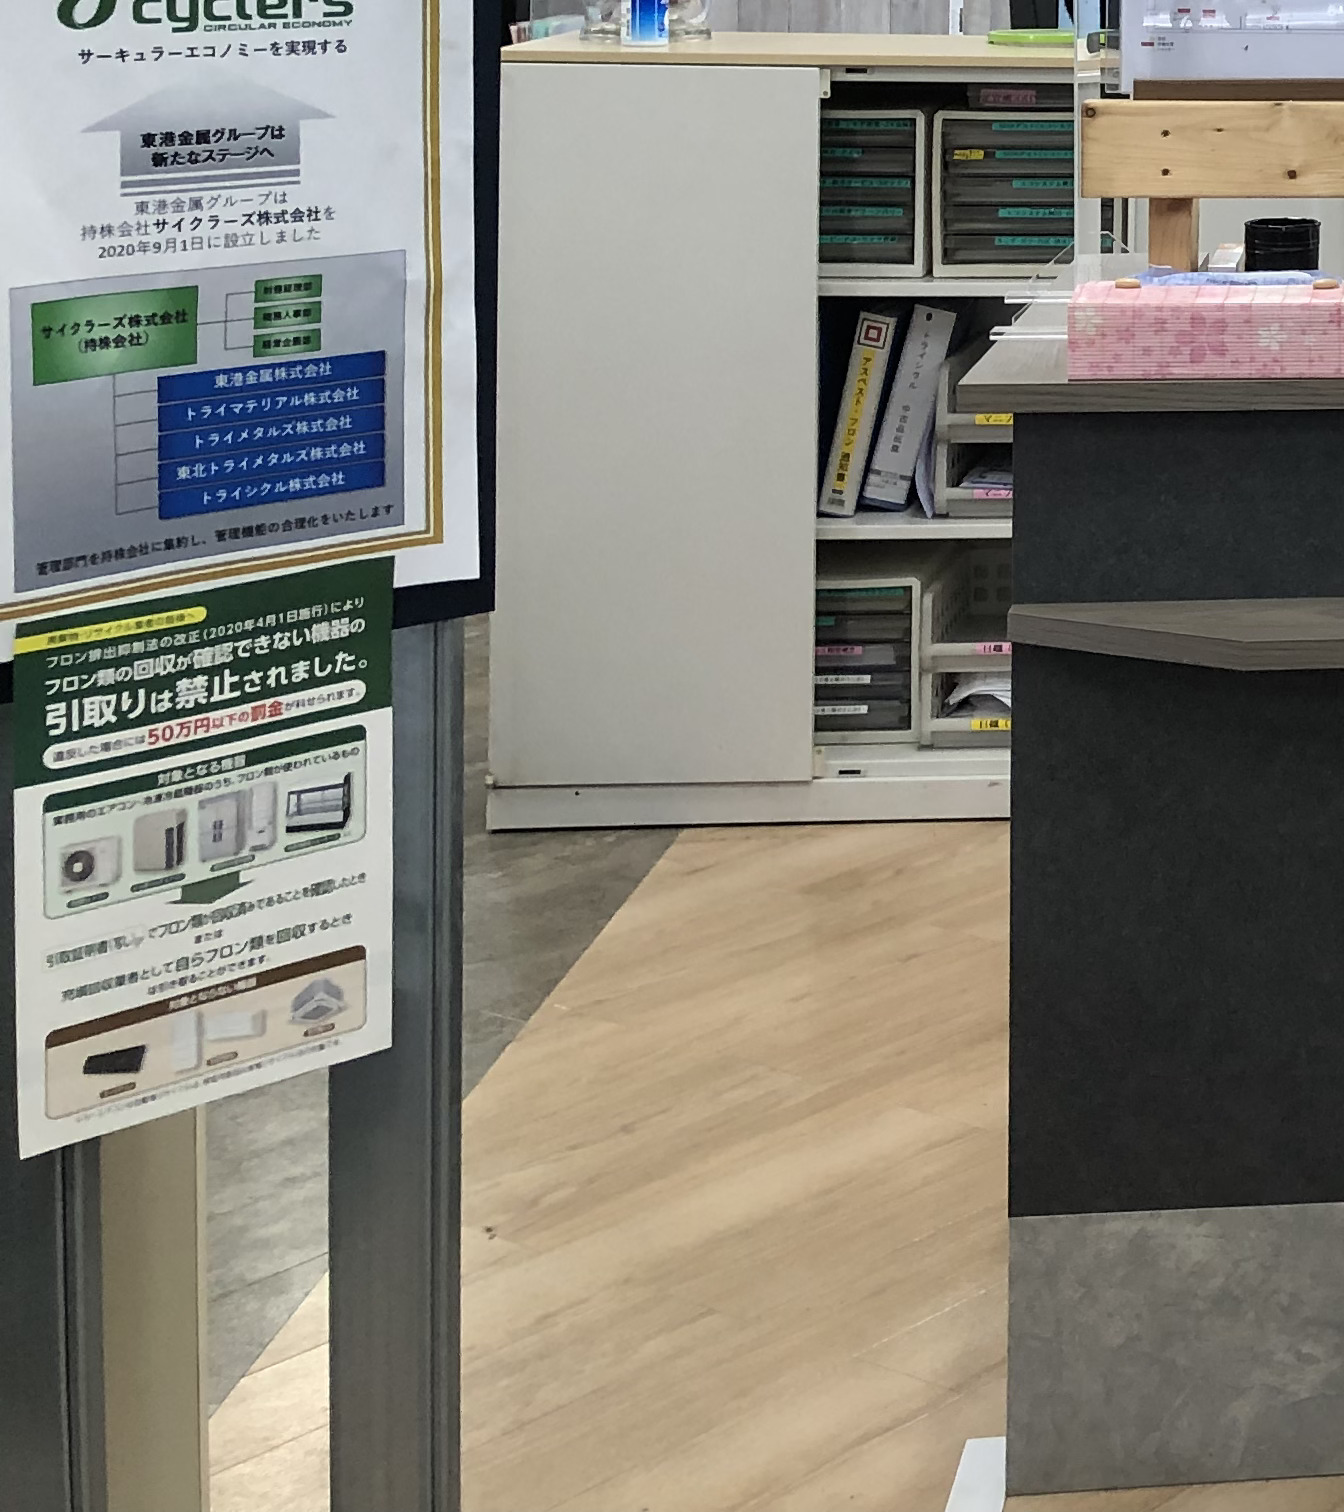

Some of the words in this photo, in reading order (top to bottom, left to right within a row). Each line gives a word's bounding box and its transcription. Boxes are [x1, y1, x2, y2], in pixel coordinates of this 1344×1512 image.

[203, 22, 277, 32] CIRCULAR
[78, 38, 348, 64] サーキュラーエコノミーを実現する
[140, 125, 286, 148] 東港金属グループは
[151, 146, 275, 168] 新たなステージへ
[134, 191, 289, 216] 東港金属グループは
[80, 205, 336, 242] 持株会社サイクラーズ株式会社を
[40, 308, 189, 340] サイクラーズ株式会社
[215, 362, 333, 388] 東港金属株式会社
[187, 387, 360, 421] トライマテリアル株式会社
[194, 415, 353, 449] トライメタルズ株式会社
[177, 441, 367, 481] 東北トライメタルズ株式会社
[202, 472, 346, 505] トライシクル株式会社
[45, 651, 368, 737] 引取りは禁止されました。
